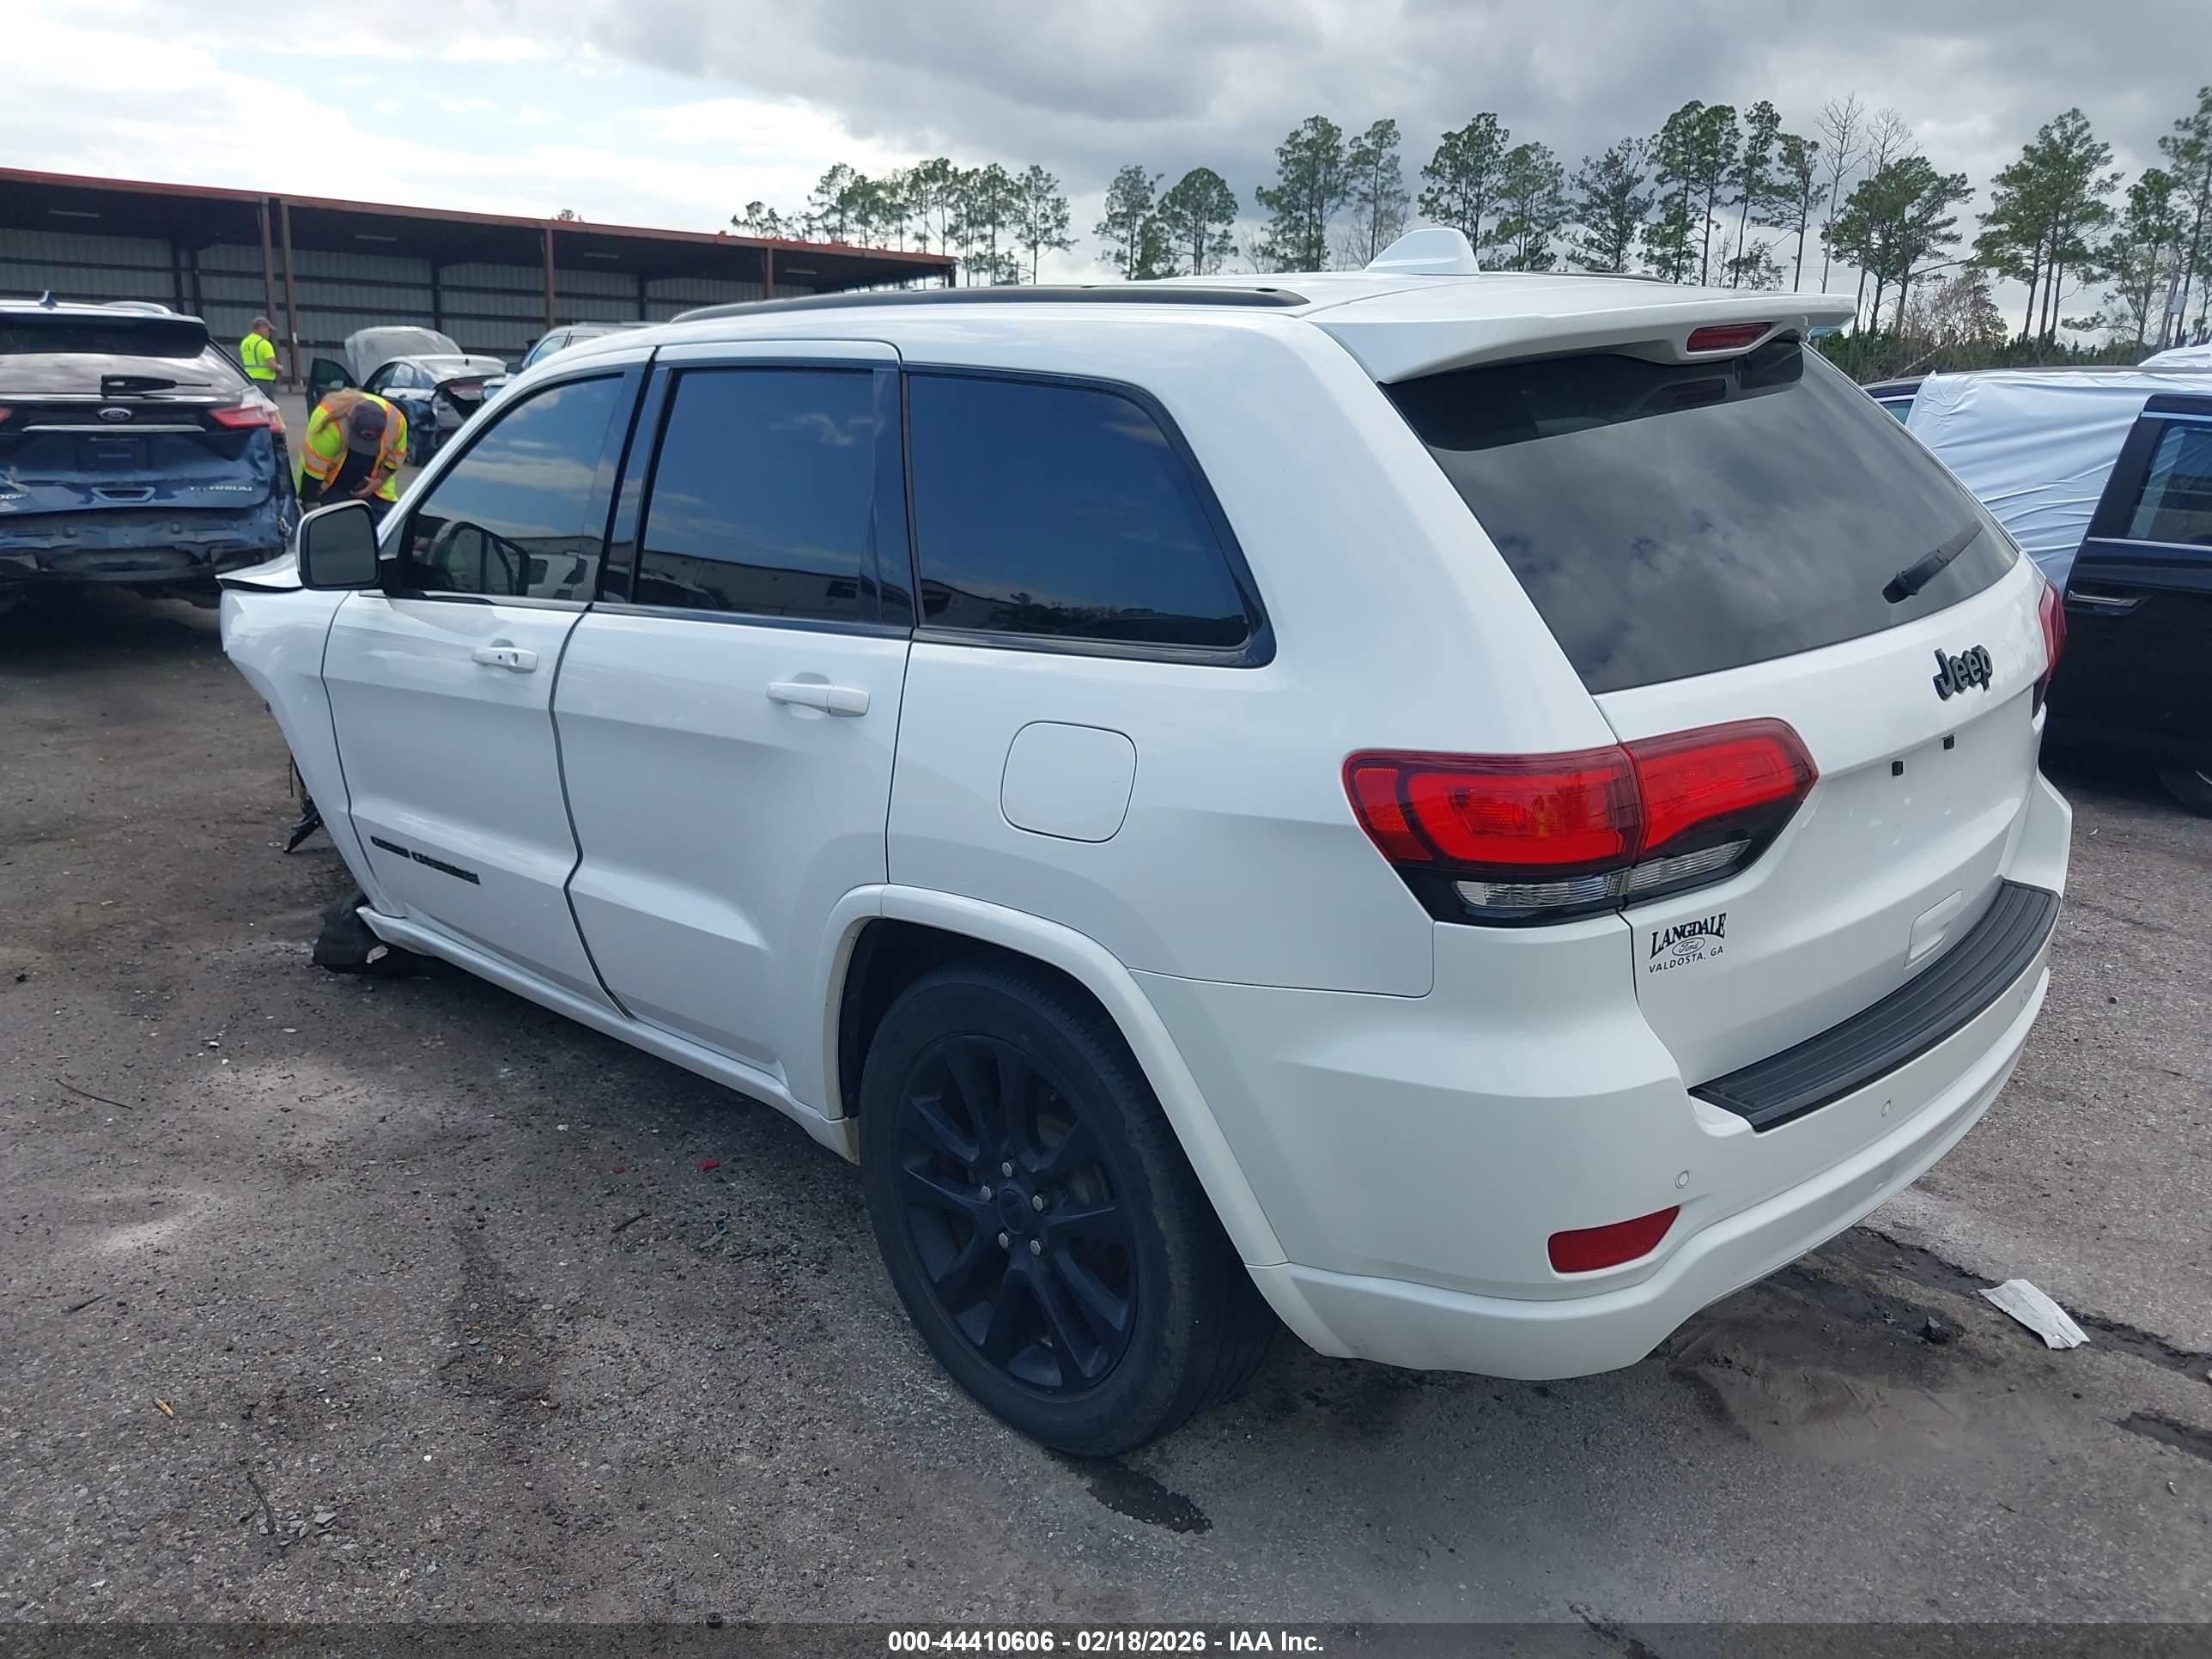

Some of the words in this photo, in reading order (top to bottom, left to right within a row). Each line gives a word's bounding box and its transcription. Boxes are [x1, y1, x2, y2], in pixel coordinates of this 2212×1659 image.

[1932, 644, 1993, 702] Jeep
[1650, 912, 1727, 960] LANGDALE
[1679, 940, 1700, 953] Ford
[1711, 945, 1723, 957] GA
